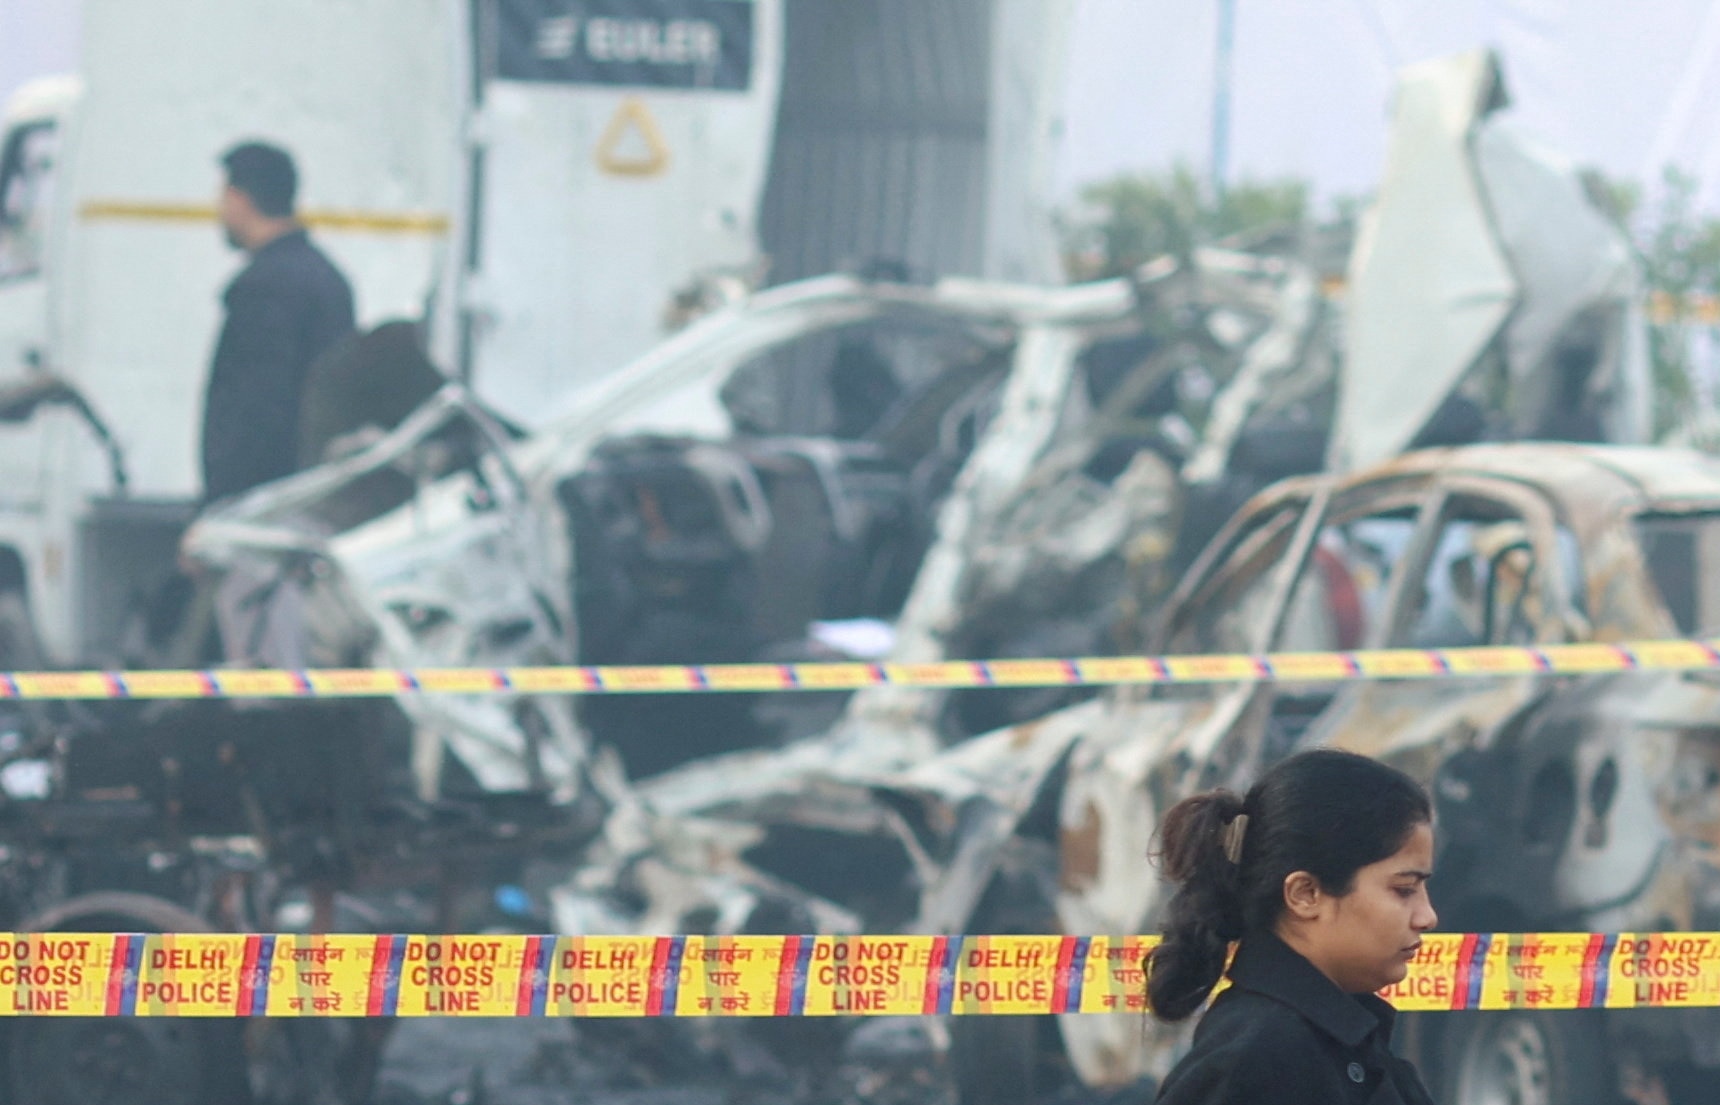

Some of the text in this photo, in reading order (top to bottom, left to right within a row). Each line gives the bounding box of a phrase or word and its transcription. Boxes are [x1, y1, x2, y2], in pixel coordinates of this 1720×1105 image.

[585, 16, 720, 64] EULER
[0, 941, 90, 961] DO NOT
[291, 942, 345, 964] लाईन
[408, 942, 502, 962] DO NOT
[701, 943, 753, 964] लाईन
[815, 943, 908, 961] DO NOT
[1106, 942, 1149, 963] लाई
[1618, 939, 1711, 955] DO NOT
[152, 950, 225, 969] DELHI
[562, 950, 635, 970] DELHI
[968, 950, 1041, 968] DELHI
[1621, 957, 1700, 977] CROSS
[0, 966, 83, 985] CROSS
[300, 972, 333, 987] पार
[411, 966, 494, 987] CROSS
[709, 972, 741, 987] पार
[819, 966, 900, 985] CROSS
[1113, 969, 1145, 983] पार
[1513, 963, 1545, 979] पार
[13, 990, 69, 1010] LINE
[142, 983, 232, 1003] POLICE
[424, 991, 480, 1011] LINE
[553, 983, 642, 1003] POLICE
[832, 990, 887, 1010] LINE
[959, 981, 1047, 1001] POLICE
[1503, 989, 1518, 1003] न
[1634, 982, 1689, 1002] LINE
[289, 991, 342, 1012] न करें
[697, 991, 751, 1012] न करें
[1101, 995, 1118, 1008] न
